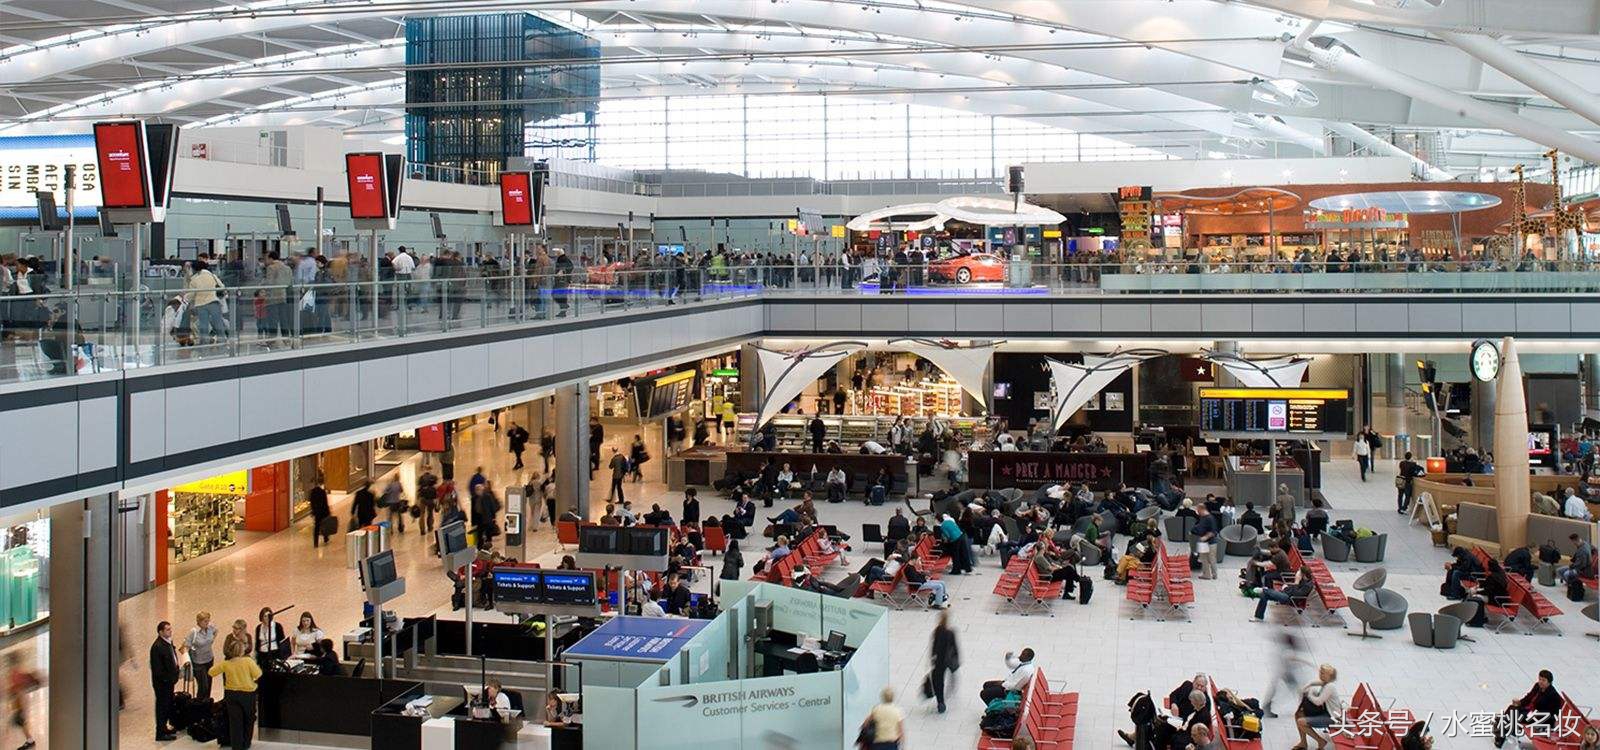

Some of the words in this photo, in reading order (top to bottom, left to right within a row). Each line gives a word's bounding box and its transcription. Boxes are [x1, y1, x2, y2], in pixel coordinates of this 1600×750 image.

[8, 165, 21, 190] SIN
[26, 164, 39, 193] MBA
[45, 164, 58, 191] AEP
[82, 163, 96, 191] OSA
[1015, 462, 1039, 478] PRET
[1043, 462, 1050, 478] A
[1055, 463, 1097, 479] MANGER
[702, 691, 745, 705] BRITISH
[748, 686, 796, 701] AIRWAYS
[702, 704, 748, 717] Customer
[751, 700, 790, 712] Services
[798, 695, 831, 708] Central
